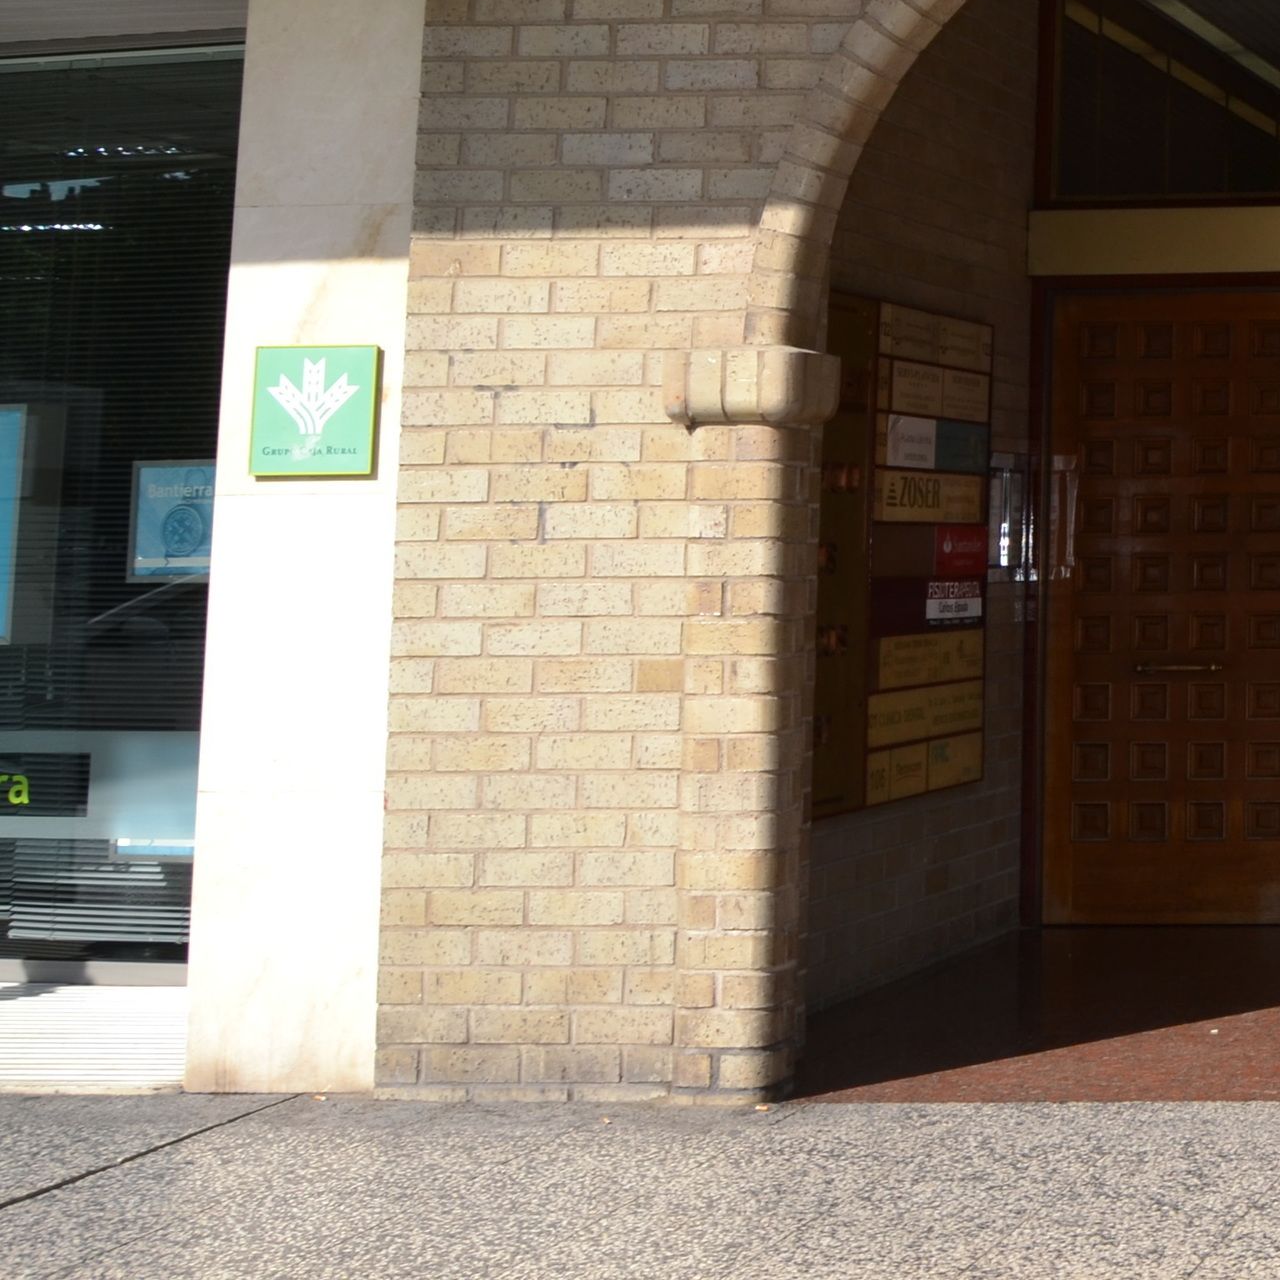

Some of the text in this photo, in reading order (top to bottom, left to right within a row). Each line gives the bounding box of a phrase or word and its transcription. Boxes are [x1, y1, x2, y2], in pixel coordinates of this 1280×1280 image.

[262, 446, 298, 456] GRUP
[326, 446, 358, 456] RURAL
[148, 483, 213, 498] Bantierra
[899, 476, 941, 509] ZOSER
